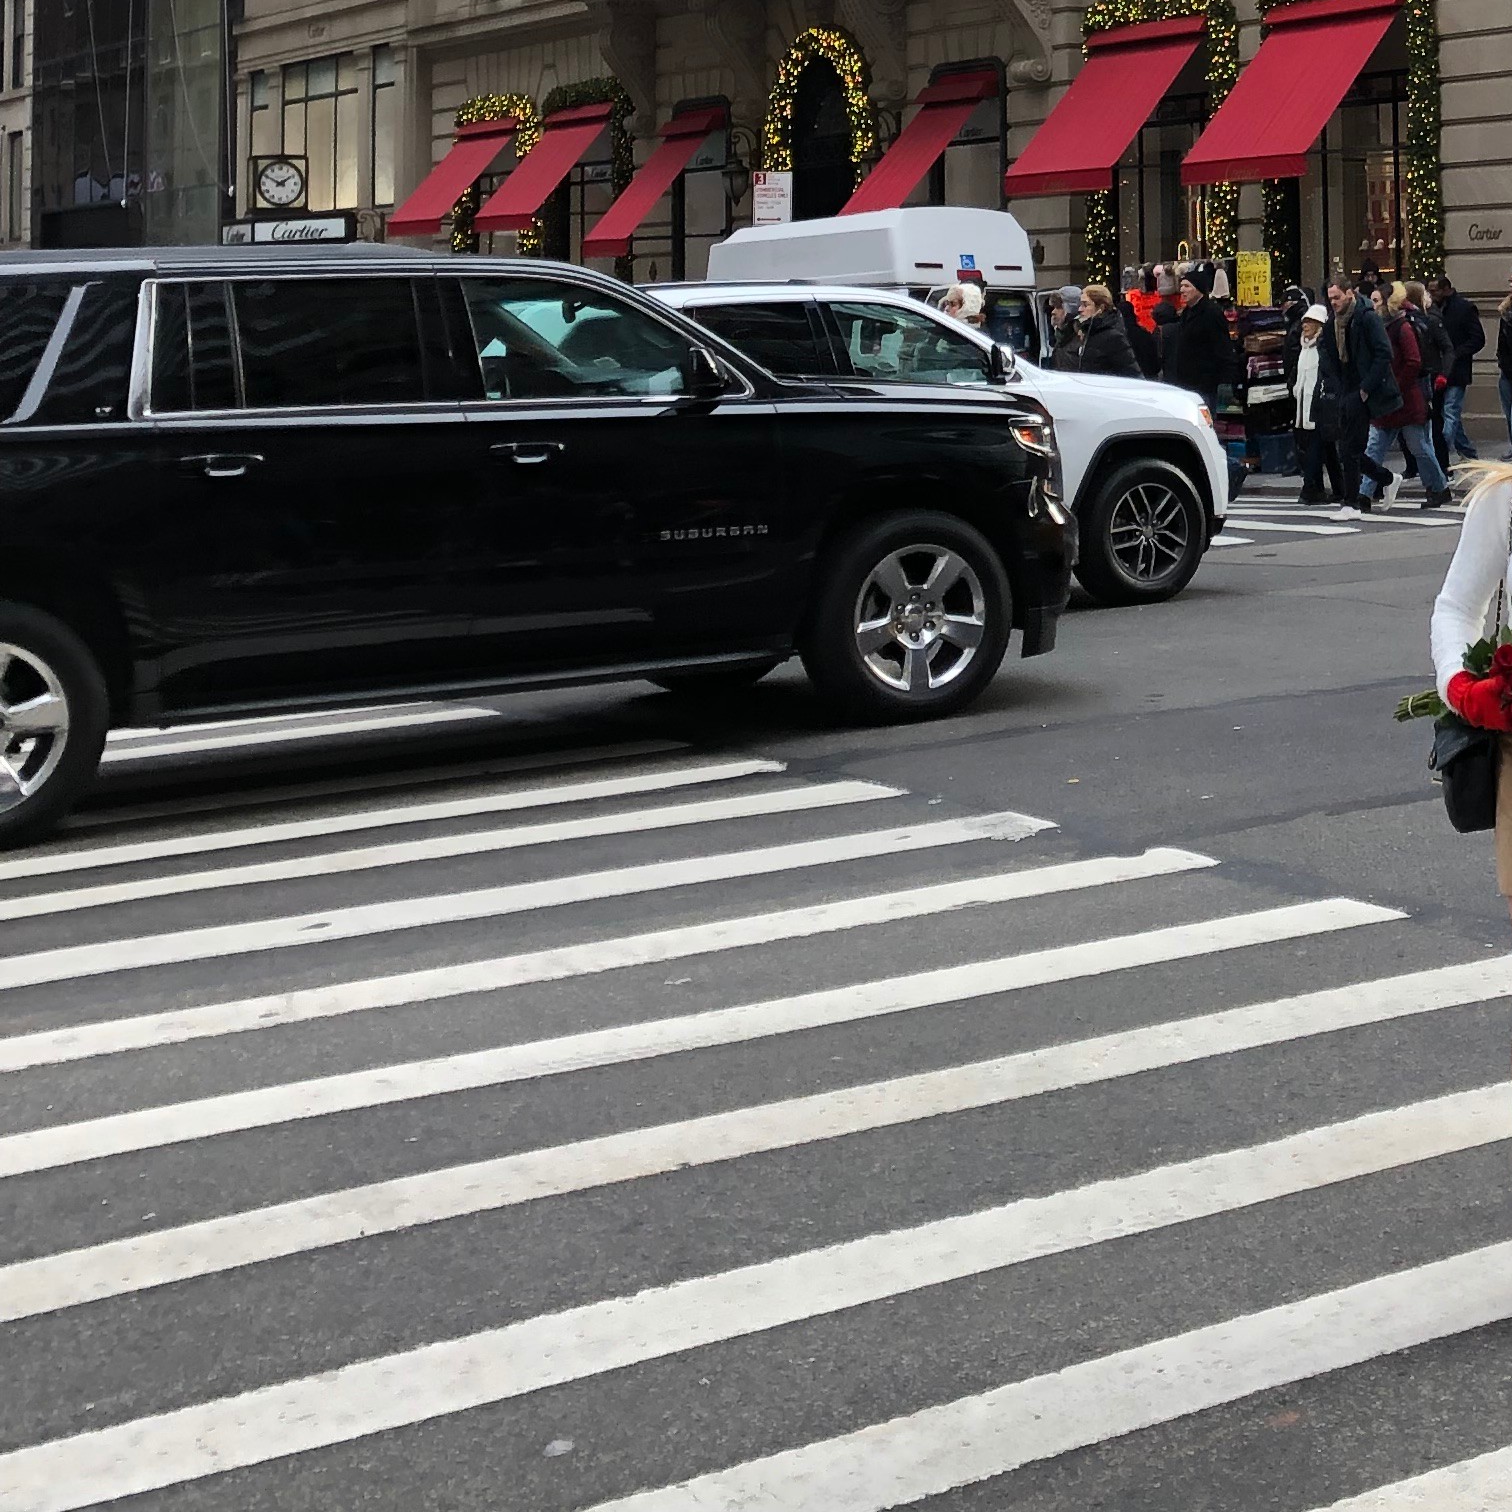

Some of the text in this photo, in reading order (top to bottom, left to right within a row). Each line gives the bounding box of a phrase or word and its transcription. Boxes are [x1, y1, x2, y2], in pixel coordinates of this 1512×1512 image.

[271, 221, 328, 241] Cartier
[1468, 223, 1503, 241] Cartier
[659, 524, 768, 541] SUBURBAN
